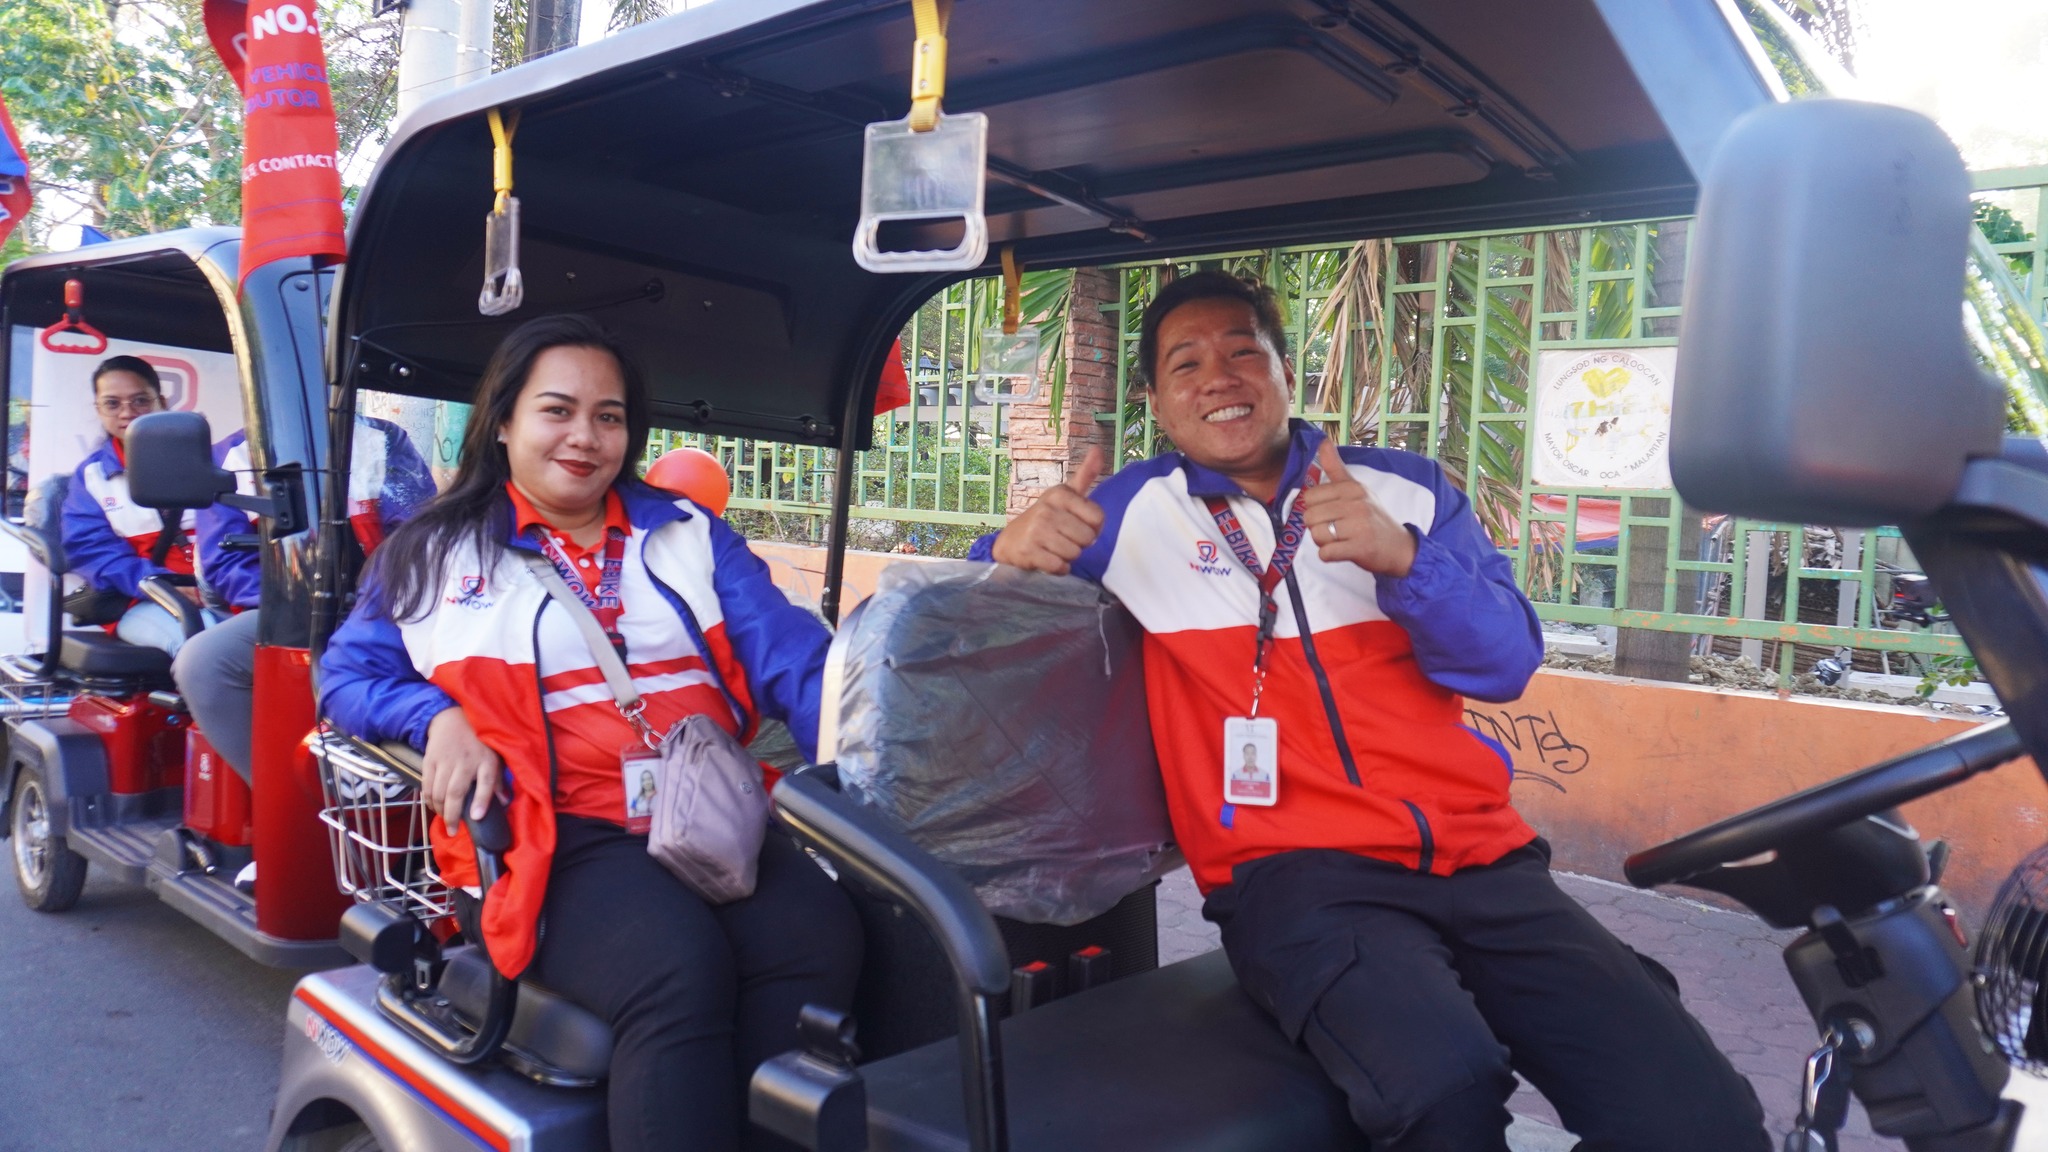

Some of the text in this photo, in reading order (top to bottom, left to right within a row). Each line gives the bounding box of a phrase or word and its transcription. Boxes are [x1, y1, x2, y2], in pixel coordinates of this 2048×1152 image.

[259, 154, 334, 172] CONTACT
[1553, 354, 1662, 390] LUNGSOD NG CALOOCAN
[1544, 432, 1563, 461] MAYOR
[1562, 459, 1590, 478] OSCAR
[1630, 431, 1667, 471] MALAPITAN
[1214, 509, 1264, 574] E-BIKE
